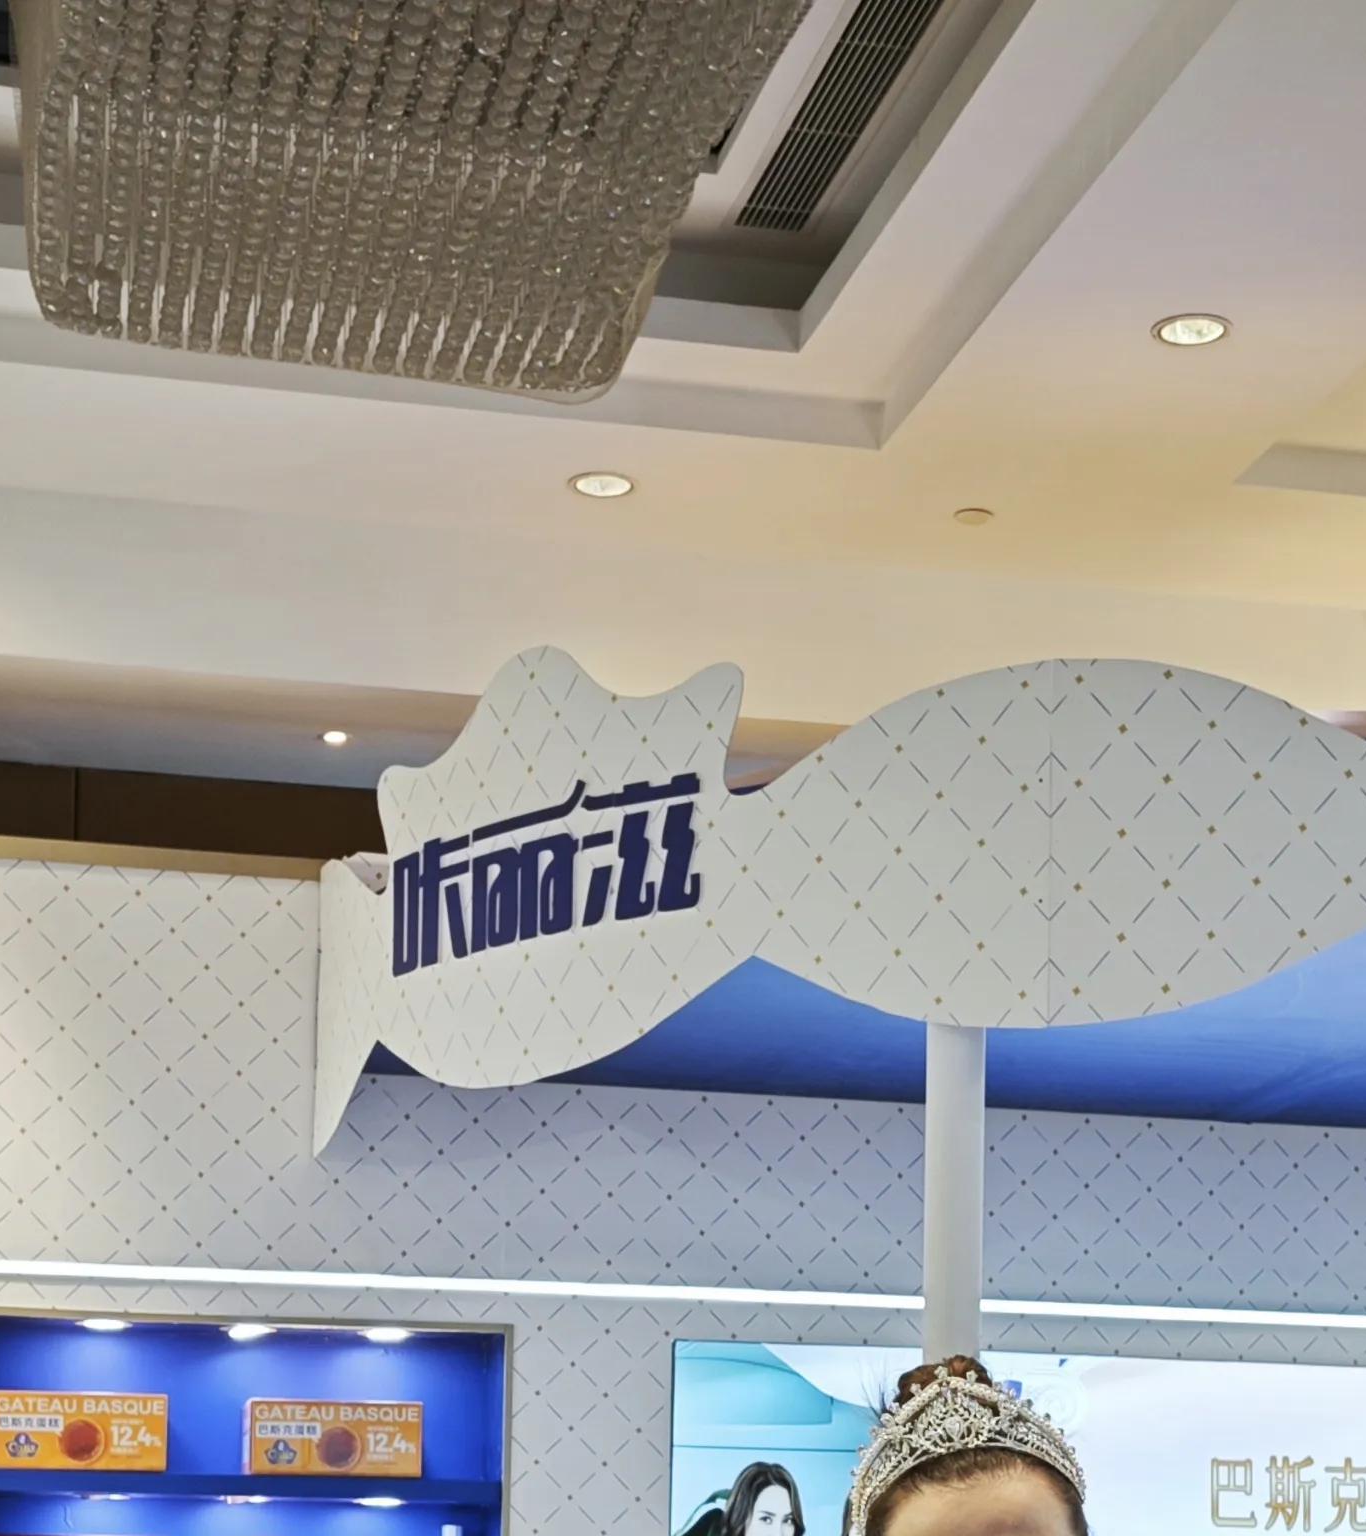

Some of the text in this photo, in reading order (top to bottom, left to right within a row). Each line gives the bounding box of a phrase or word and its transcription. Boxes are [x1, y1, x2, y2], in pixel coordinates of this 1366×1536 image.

[83, 1399, 164, 1415] BASQUE
[256, 1405, 420, 1422] GATEAU BASQUE
